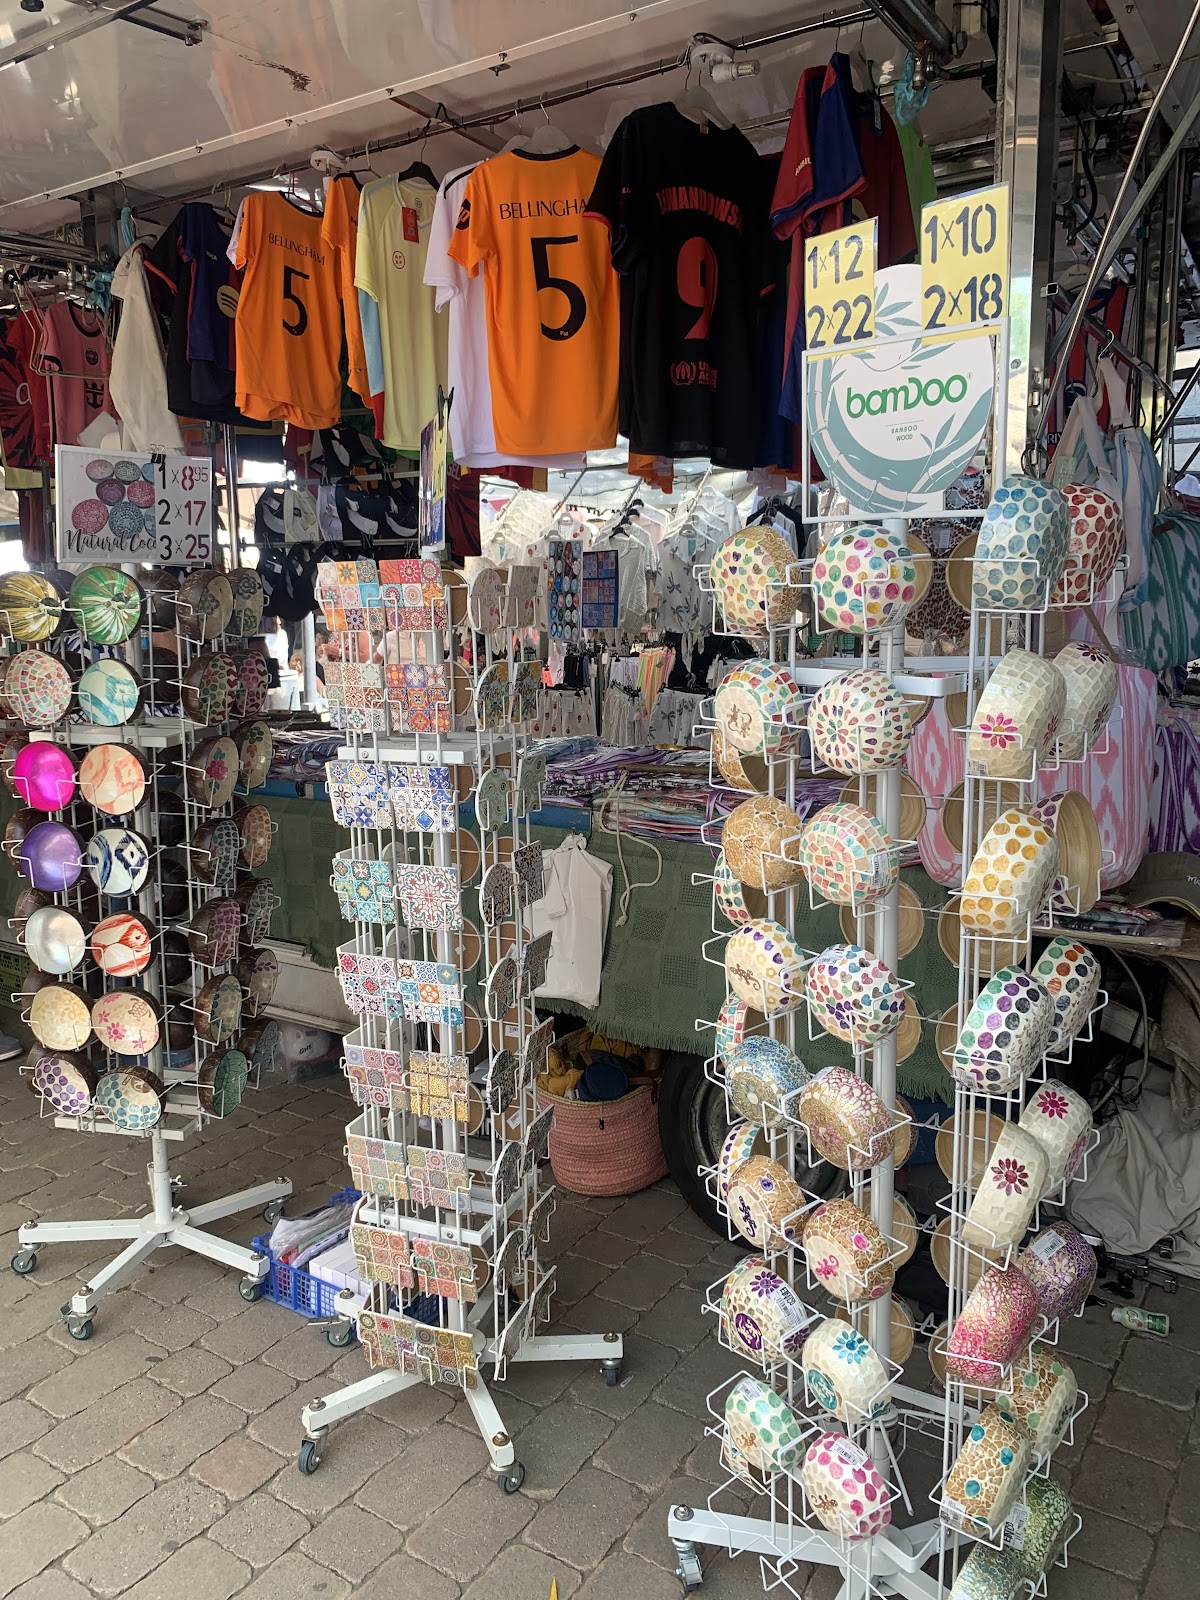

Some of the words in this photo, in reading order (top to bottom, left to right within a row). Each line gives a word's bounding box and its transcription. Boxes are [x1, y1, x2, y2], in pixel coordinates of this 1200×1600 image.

[268, 232, 326, 266] BELLINGHAM
[282, 265, 310, 336] 5
[531, 234, 587, 341] 5
[677, 236, 719, 340] 9
[890, 425, 918, 434] BAMBOO
[896, 434, 914, 442] WOOD
[66, 528, 128, 554] Natural
